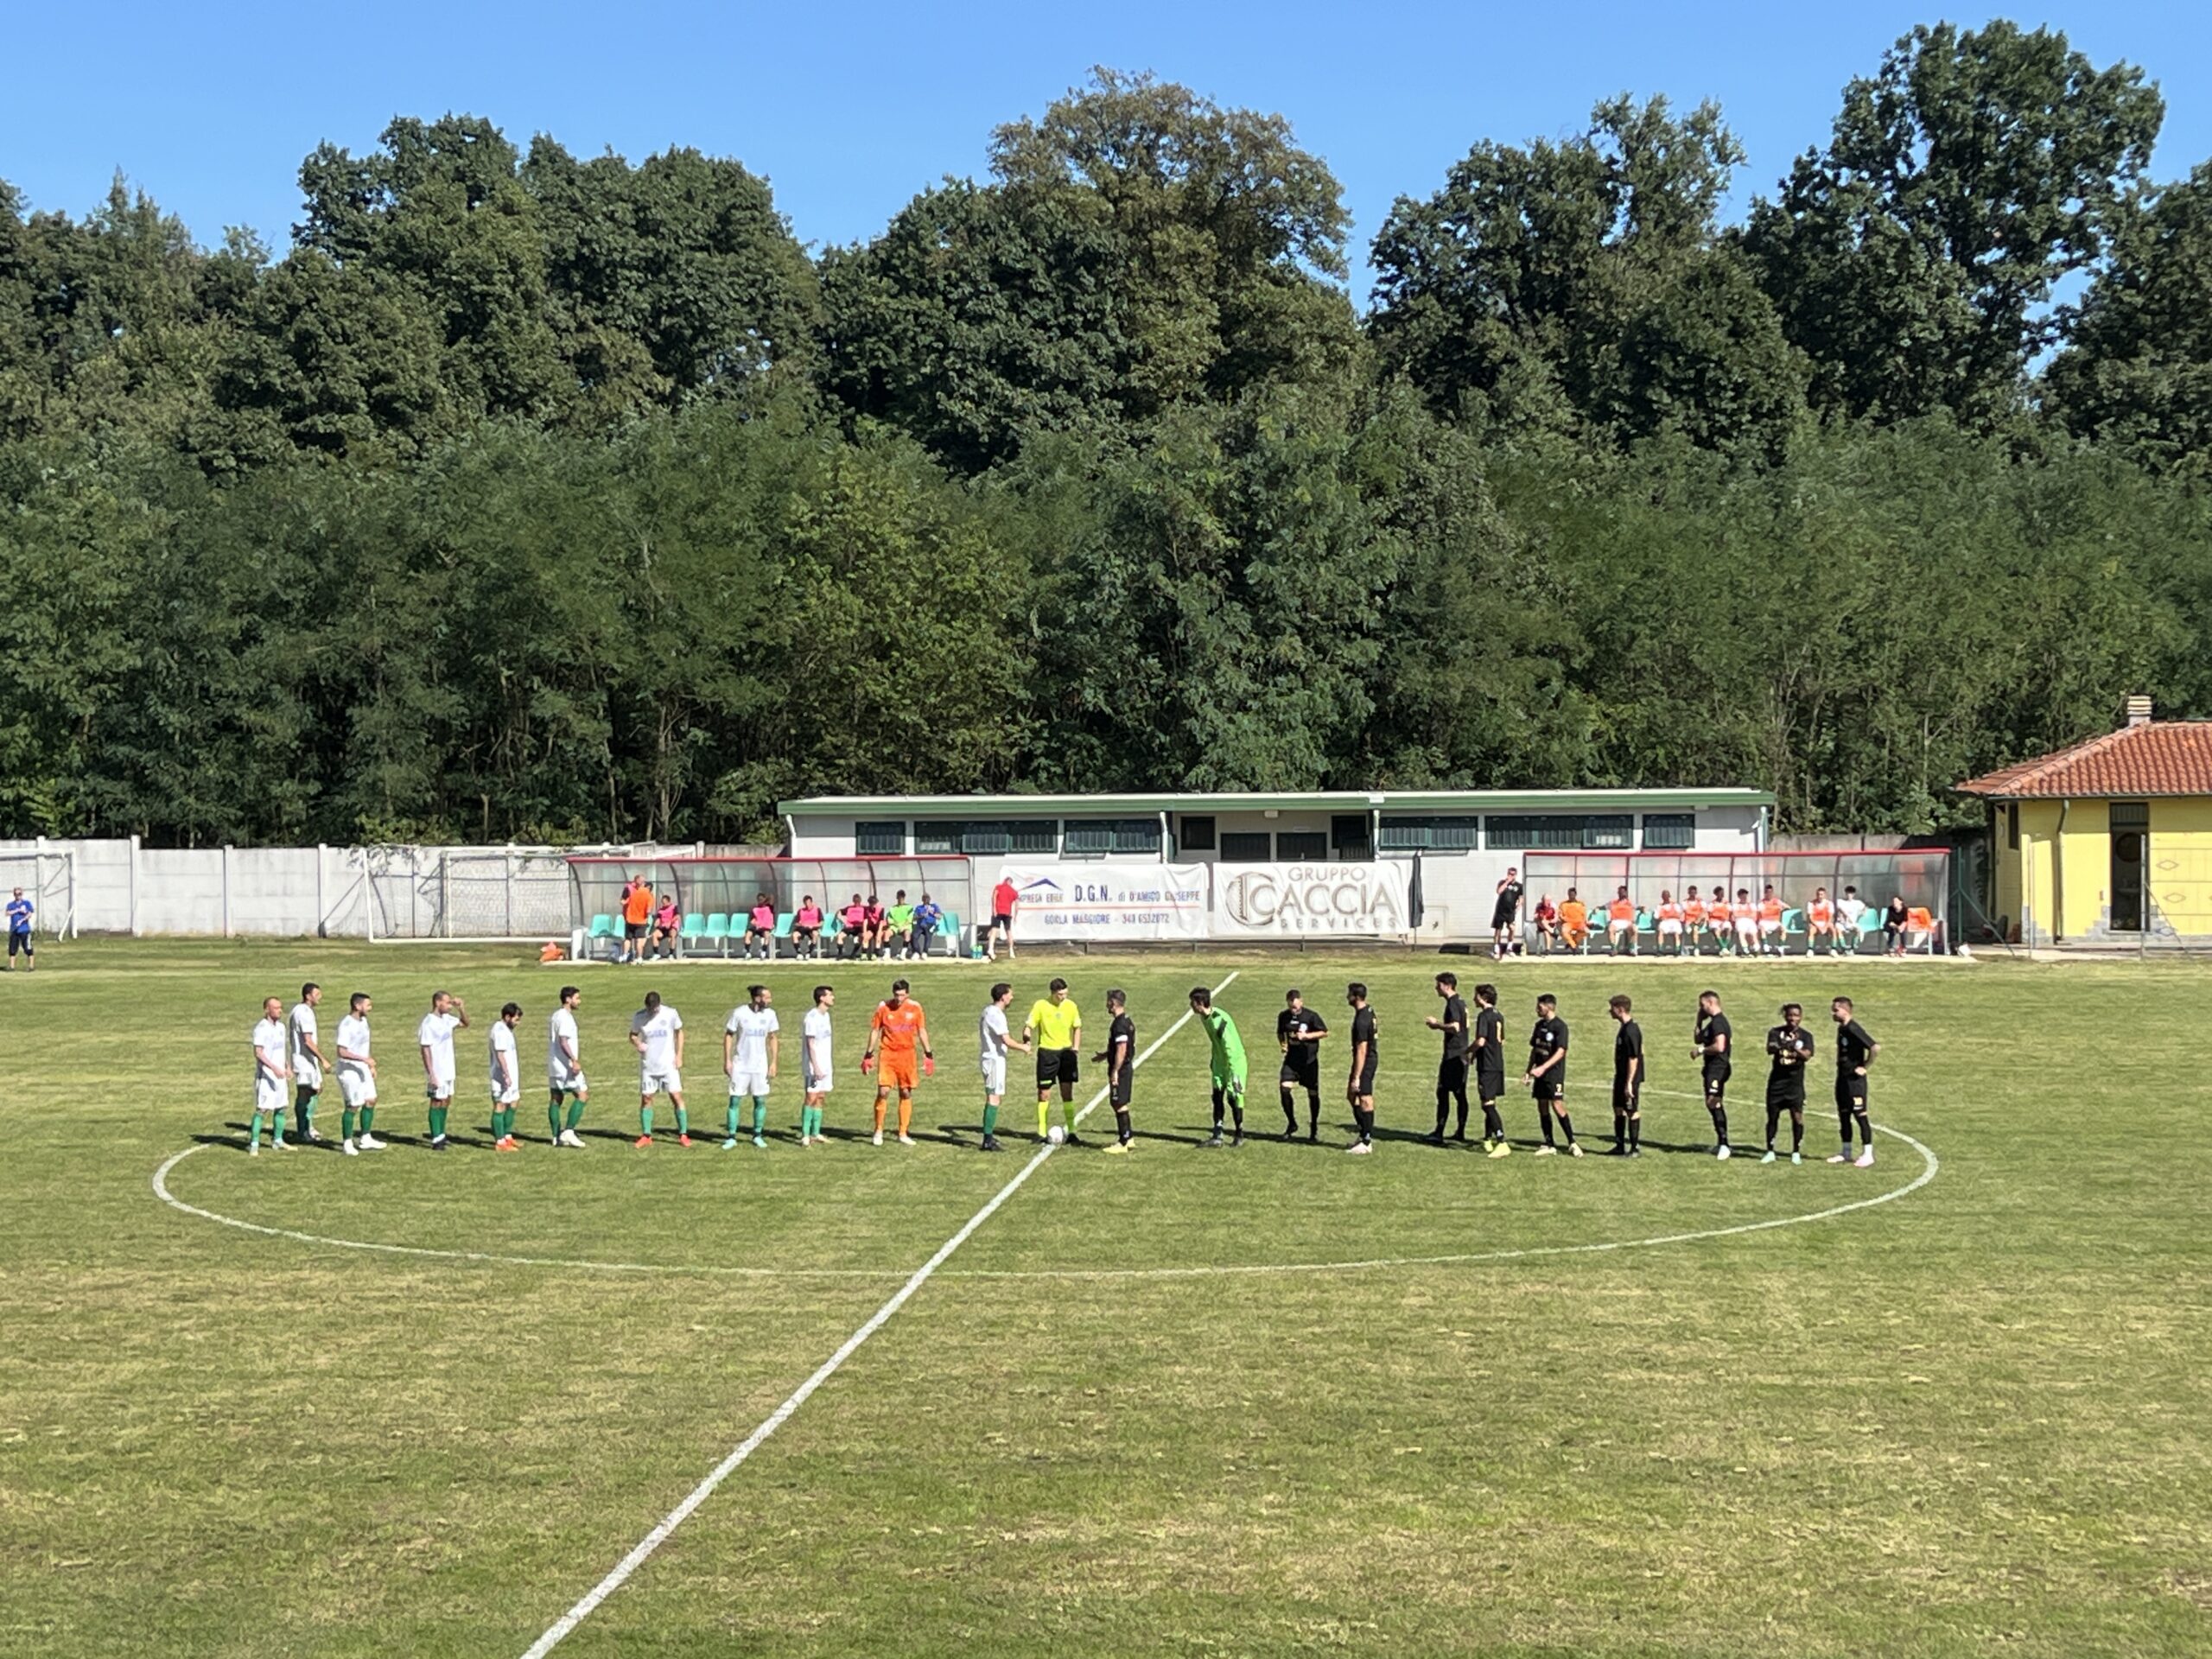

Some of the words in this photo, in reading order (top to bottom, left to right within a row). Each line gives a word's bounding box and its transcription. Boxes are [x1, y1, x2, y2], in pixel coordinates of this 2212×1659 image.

[1287, 867, 1366, 881] GRUPPO
[1074, 885, 1112, 902] D.G.N.
[1249, 883, 1396, 916] CACCIA
[1281, 918, 1396, 929] SERVICES
